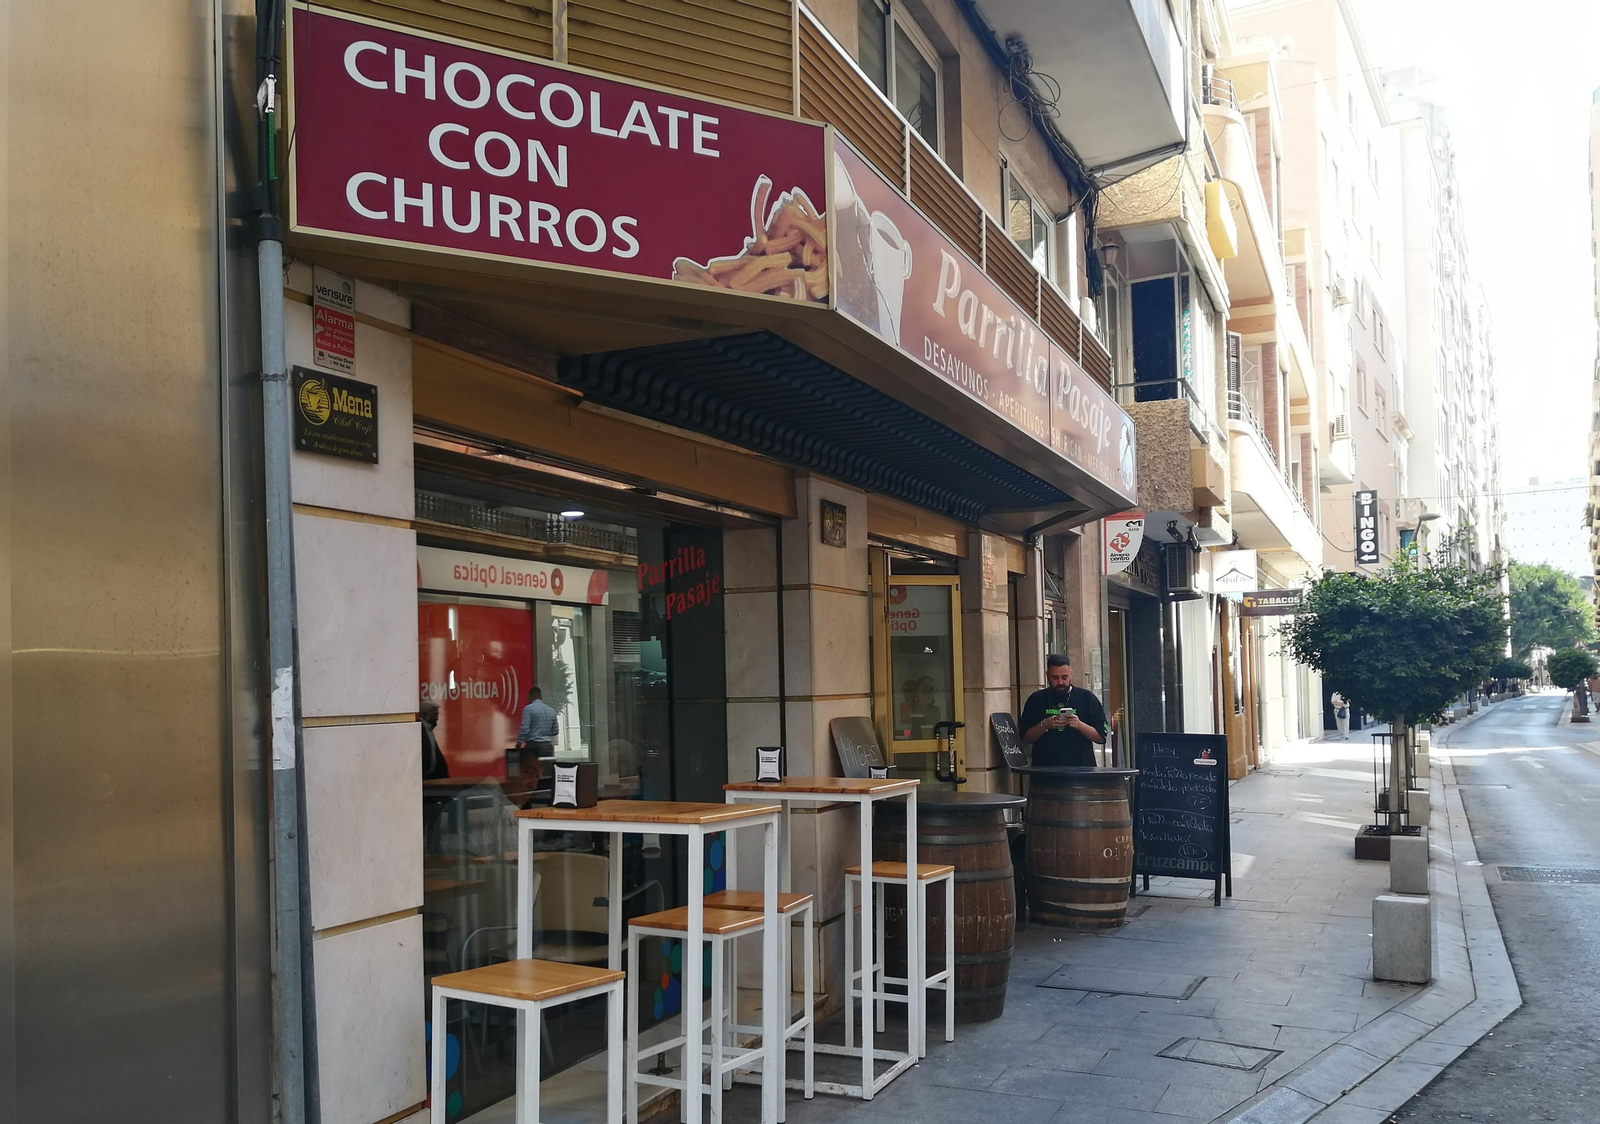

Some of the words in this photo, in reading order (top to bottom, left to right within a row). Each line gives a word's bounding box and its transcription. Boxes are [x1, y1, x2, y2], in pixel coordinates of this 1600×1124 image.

[343, 40, 720, 158] CHOCOLATE
[428, 122, 569, 187] CON
[346, 171, 640, 258] CHURROS
[316, 284, 353, 304] verisure
[316, 309, 353, 330] Alarma
[317, 338, 331, 347] Aviso
[933, 248, 1048, 397] Parrilla
[1057, 358, 1112, 454] Pasaje
[333, 387, 372, 418] Mena
[924, 335, 989, 400] DESAYUNOS
[999, 391, 1044, 439] APERITIVOS
[1361, 493, 1375, 552] BINGO
[637, 546, 706, 591] Parrilla
[666, 571, 721, 620] Pasaje
[1152, 743, 1176, 756] Hoy
